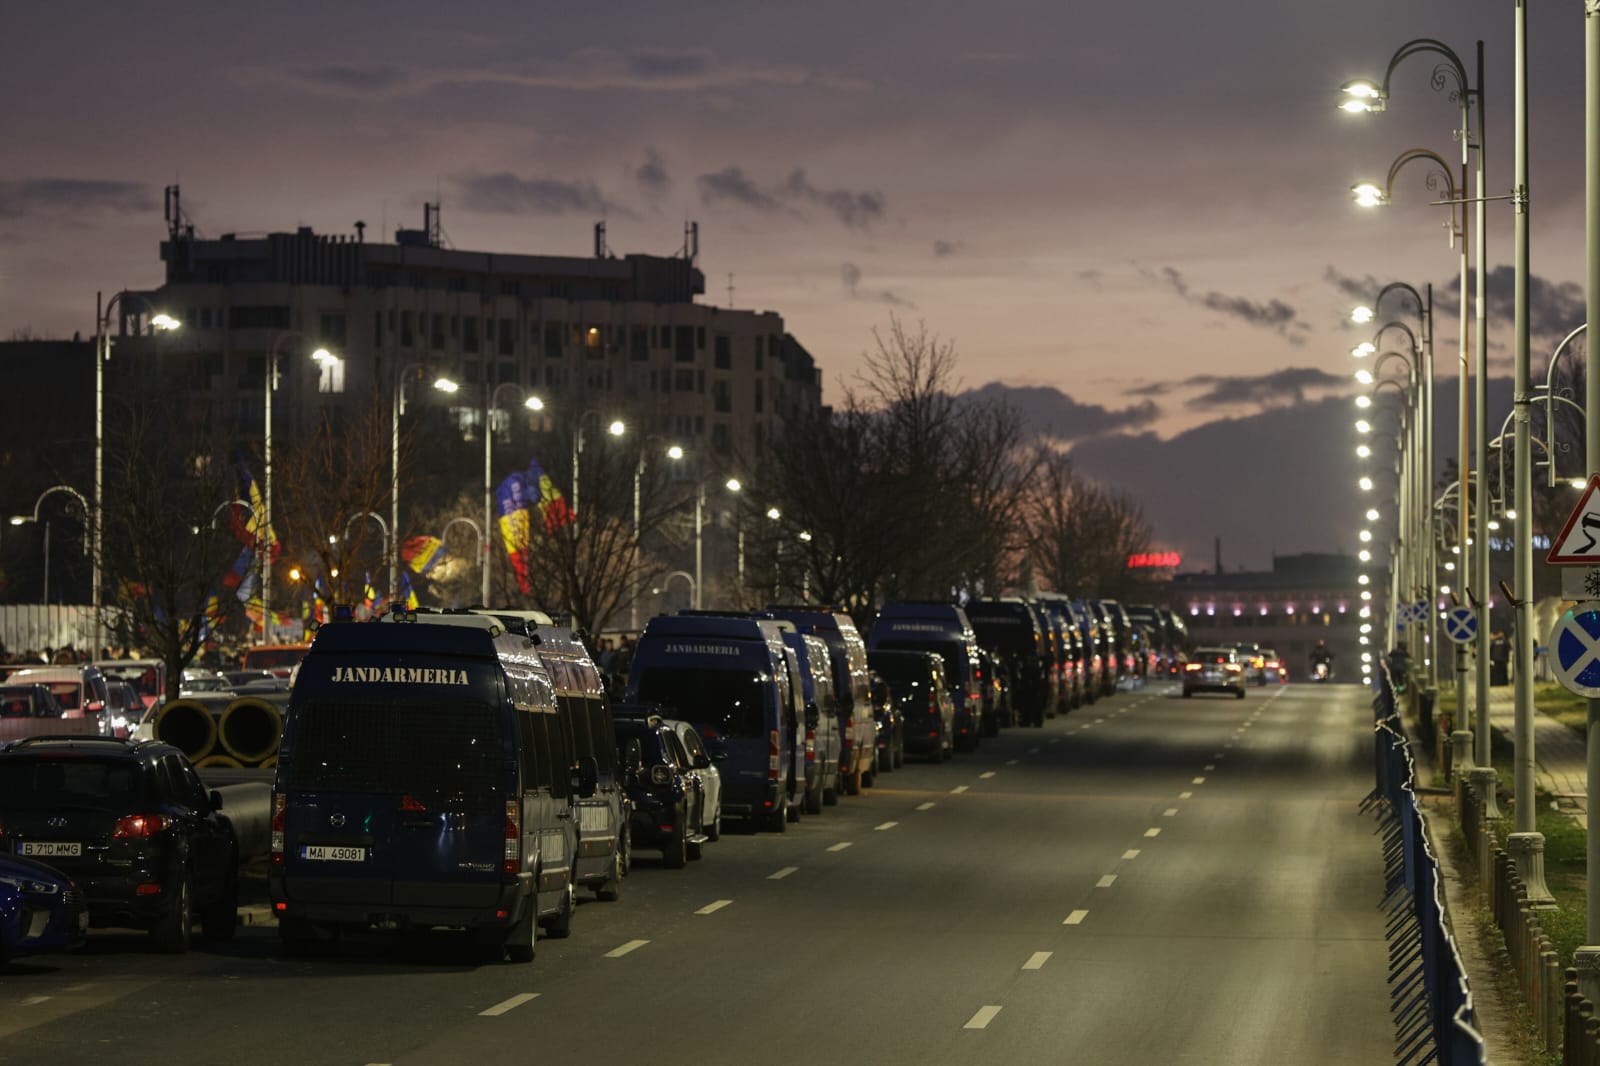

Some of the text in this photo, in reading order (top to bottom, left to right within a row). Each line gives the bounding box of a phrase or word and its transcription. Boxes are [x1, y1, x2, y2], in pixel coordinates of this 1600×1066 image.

[664, 643, 740, 656] JANDARMERIA
[331, 666, 469, 686] JANDARMERIA
[24, 844, 79, 855] B 710 MMG
[309, 847, 362, 860] MAI 49081
